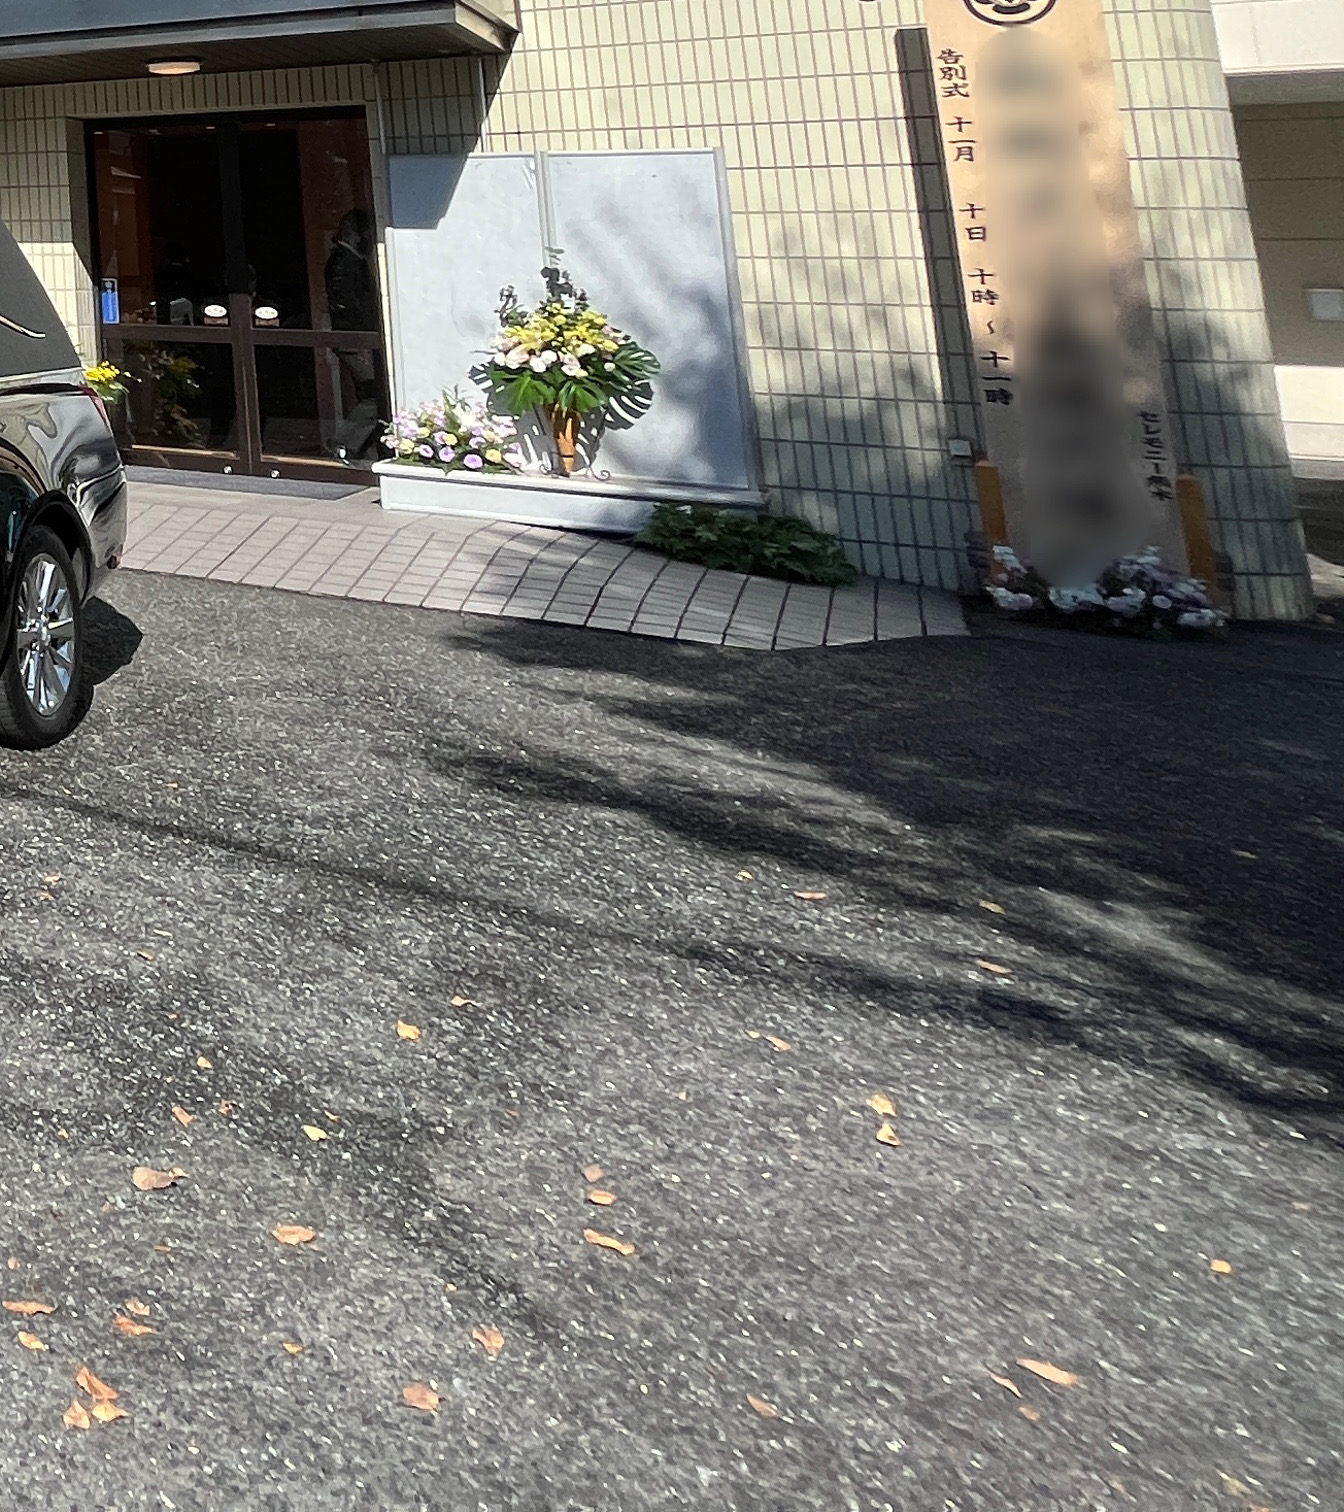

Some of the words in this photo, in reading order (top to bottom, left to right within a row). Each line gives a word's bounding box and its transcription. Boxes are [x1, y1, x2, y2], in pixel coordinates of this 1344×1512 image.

[936, 47, 970, 98] 告別式
[945, 116, 979, 163] 十一月
[958, 202, 987, 242] 十日
